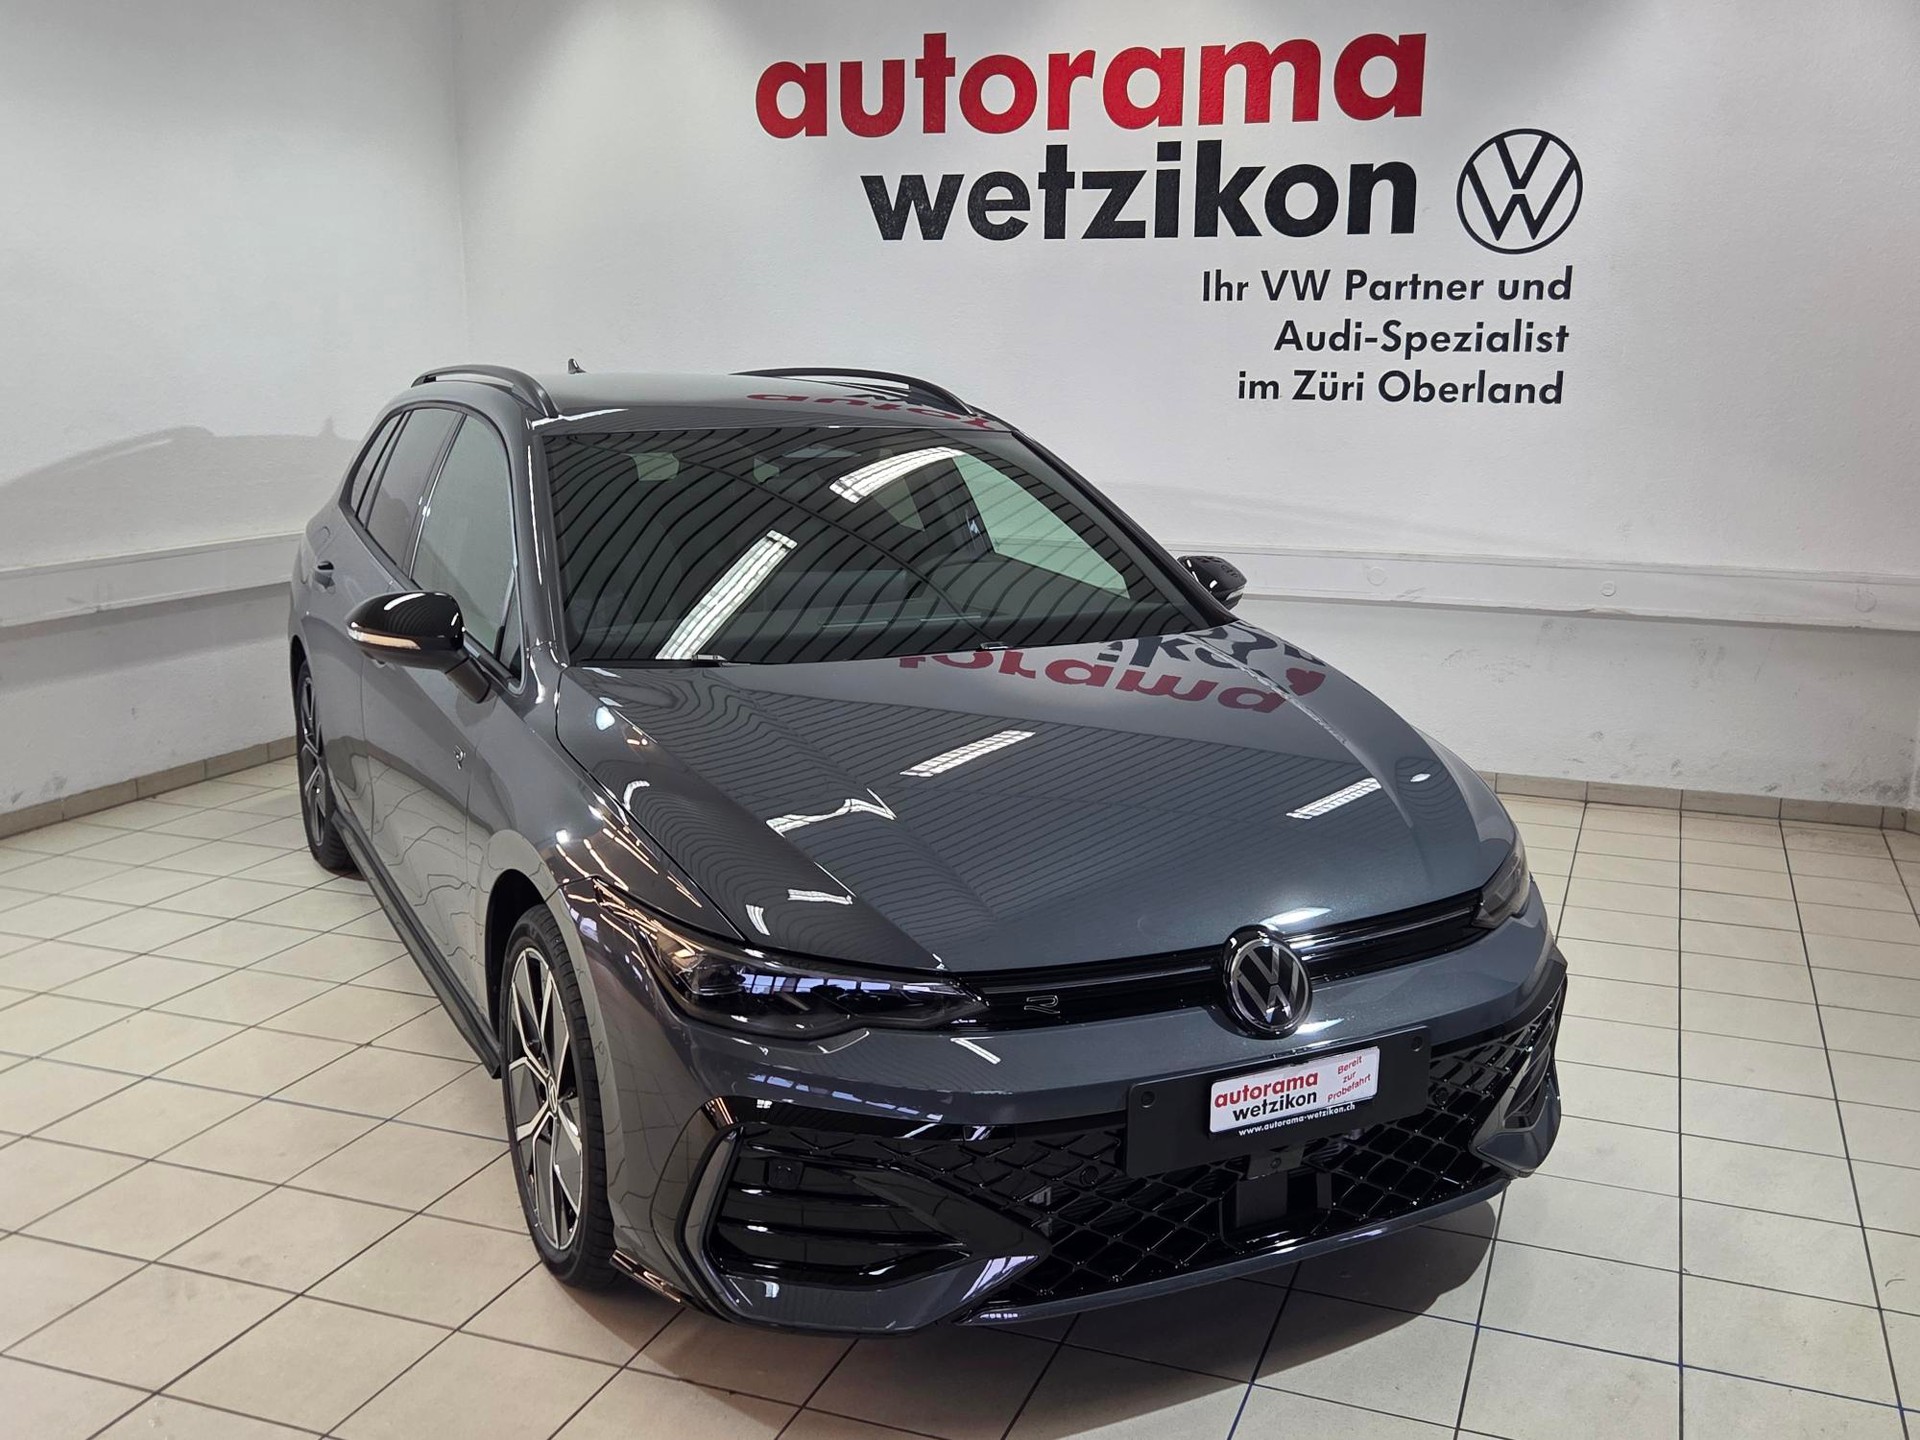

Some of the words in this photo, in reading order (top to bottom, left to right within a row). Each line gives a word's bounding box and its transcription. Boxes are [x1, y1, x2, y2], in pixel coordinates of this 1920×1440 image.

[756, 32, 1427, 138] autorama
[860, 140, 1417, 241] wetzikon
[1203, 270, 1249, 302] Ihr
[1261, 270, 1331, 301] VW
[1346, 270, 1485, 301] Partner
[1499, 265, 1573, 301] und
[1274, 319, 1570, 361] Audi-Spezialist
[1238, 371, 1280, 400] im
[1292, 370, 1364, 402] Züri
[1378, 370, 1564, 405] Oberland
[1337, 1055, 1363, 1075] Bereit
[1342, 1070, 1356, 1084] zur
[1214, 1072, 1319, 1108] autorama
[1327, 1073, 1372, 1103] Probefahrt
[1232, 1091, 1318, 1122] wetzikon
[1238, 1103, 1356, 1136] www.autorama-wetzikon.ch
